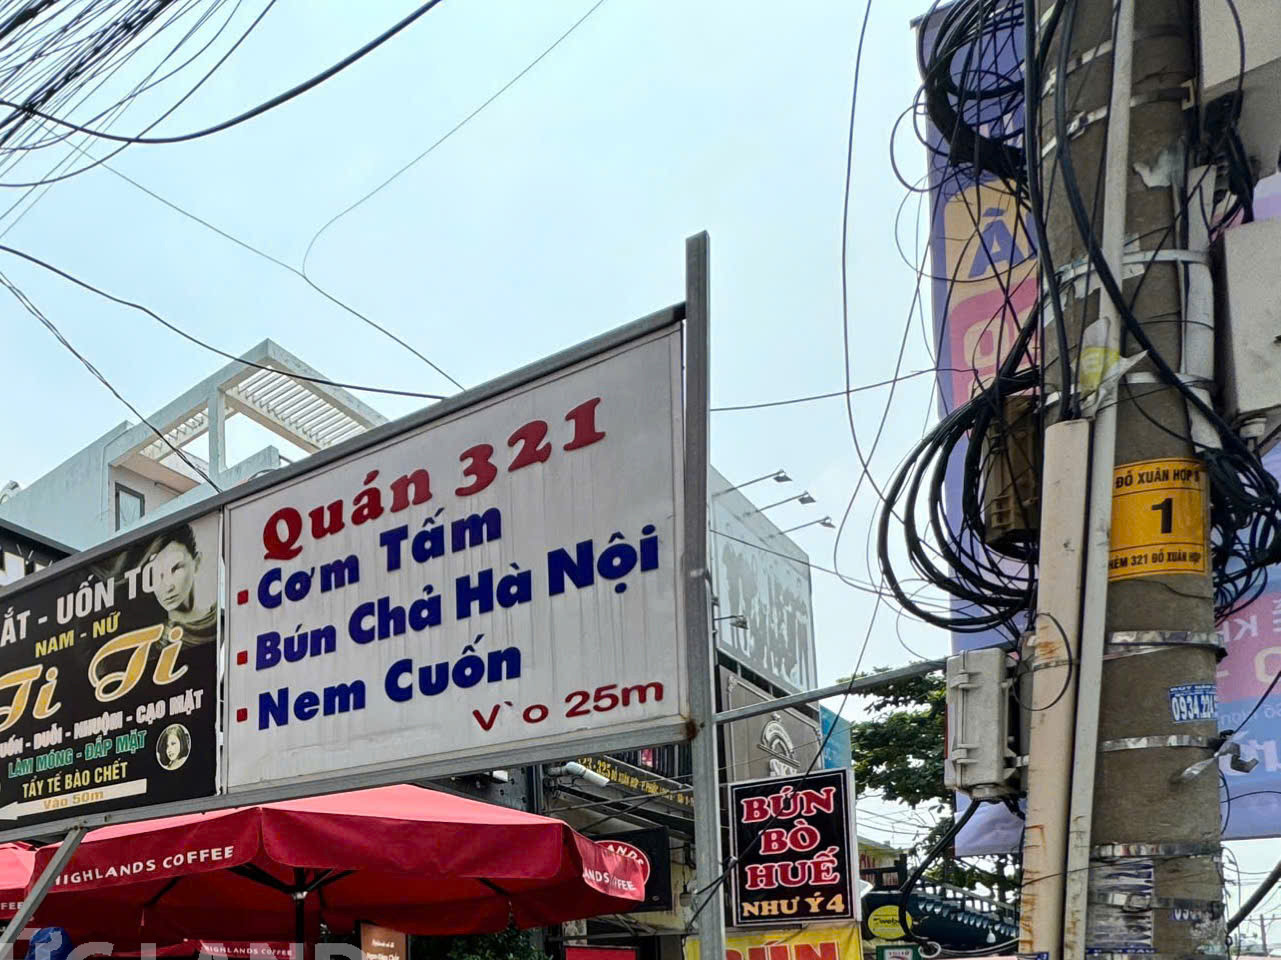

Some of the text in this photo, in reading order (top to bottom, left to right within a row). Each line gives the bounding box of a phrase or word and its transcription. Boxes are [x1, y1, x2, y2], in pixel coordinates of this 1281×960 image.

[261, 396, 607, 562] Quán 321
[1137, 467, 1169, 485] XUÂN
[1151, 497, 1174, 534] 1
[255, 506, 502, 609] Cơm Tấm
[1131, 553, 1148, 566] 321
[56, 574, 115, 625] UỐN
[254, 523, 660, 671] Bún Chả Hà Nội
[34, 611, 121, 659] NAM NỮ
[87, 623, 190, 703] Ti
[257, 633, 522, 731] Nem Cuốn
[564, 681, 665, 719] 25m
[7, 756, 34, 779] LÀM
[35, 747, 74, 772] MÓNG
[65, 769, 91, 791] BÀO
[94, 759, 129, 784] CHẾT
[72, 789, 105, 805] 50m
[740, 785, 837, 824] BÚN
[759, 818, 821, 856] BÒ
[162, 846, 235, 869] COFFEE
[745, 845, 841, 890] HUẾ
[741, 891, 846, 917] NHƯ Ý 4
